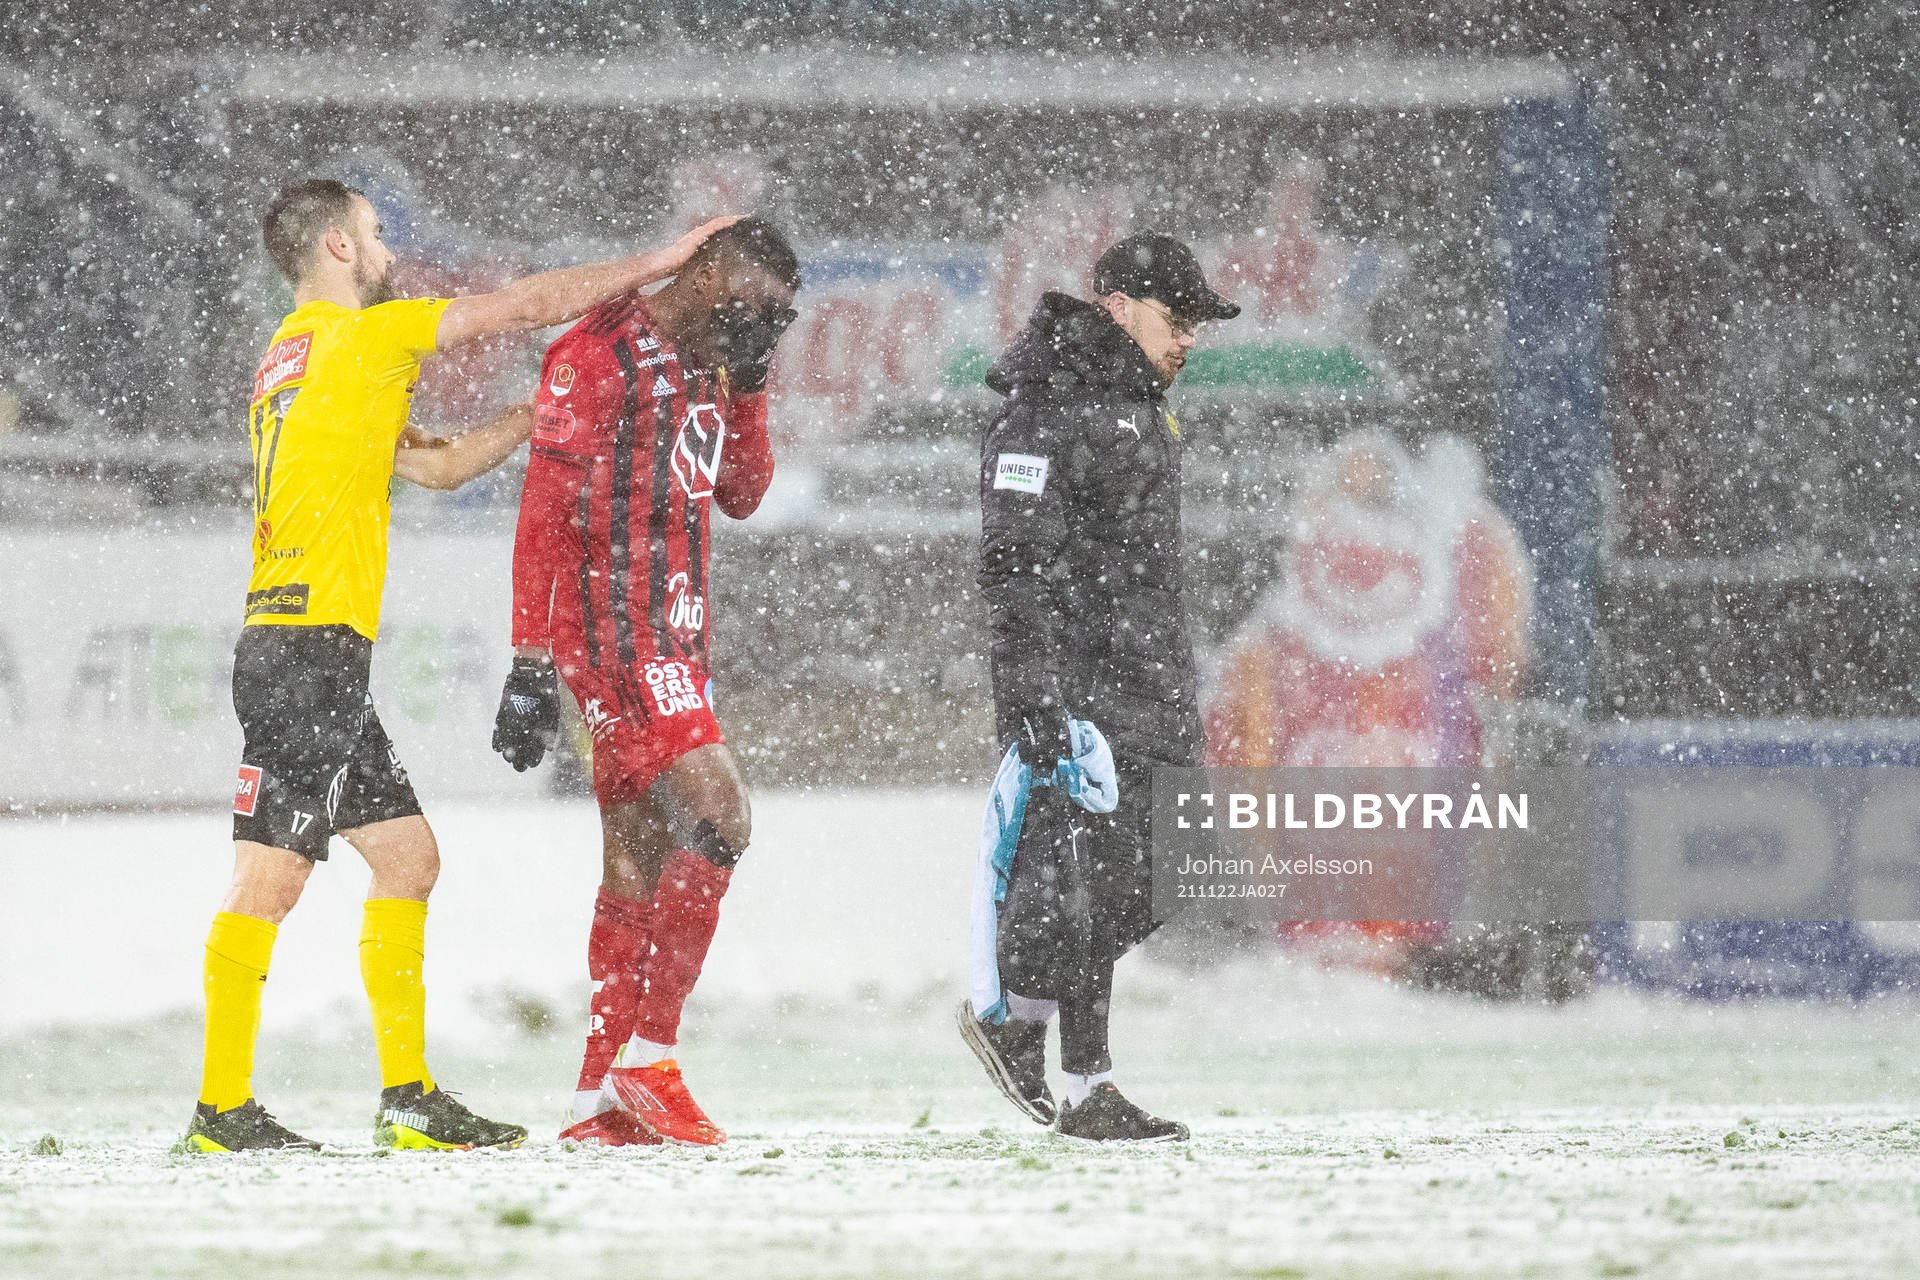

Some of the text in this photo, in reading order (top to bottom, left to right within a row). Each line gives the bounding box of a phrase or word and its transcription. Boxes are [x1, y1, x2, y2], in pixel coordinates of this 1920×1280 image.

[1000, 463, 1042, 478] UNIBET
[644, 662, 690, 686] ÖST
[651, 677, 696, 702] ERS
[657, 693, 704, 717] UND
[291, 810, 314, 835] 17
